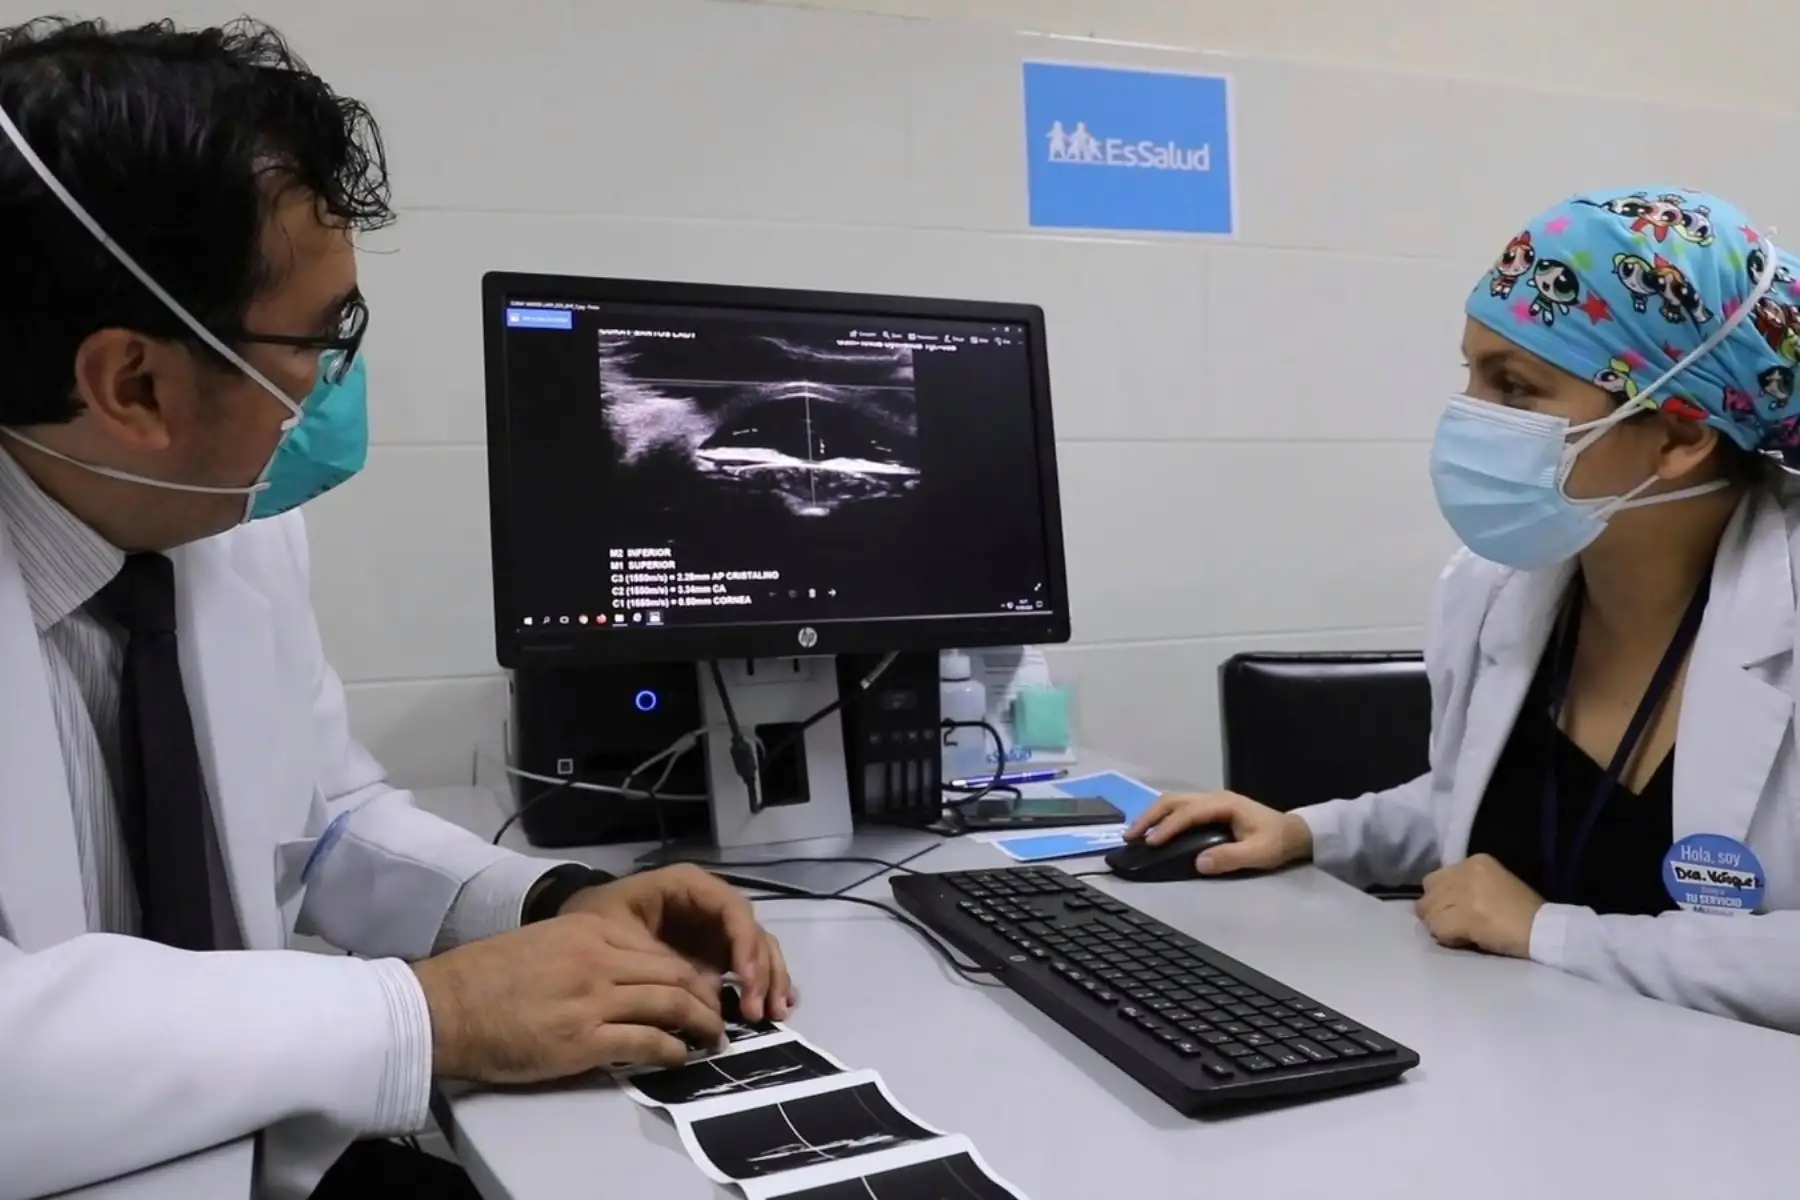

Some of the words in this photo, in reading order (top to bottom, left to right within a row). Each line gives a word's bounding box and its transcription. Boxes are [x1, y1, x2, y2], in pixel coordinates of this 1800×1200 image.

[1106, 138, 1209, 171] EsSalud
[627, 548, 672, 557] INFERIOR
[628, 560, 676, 570] SUPERIOR
[726, 570, 779, 580] CRISTALINO
[712, 584, 727, 593] CA
[713, 596, 752, 605] CORNEA
[1718, 852, 1741, 867] soy
